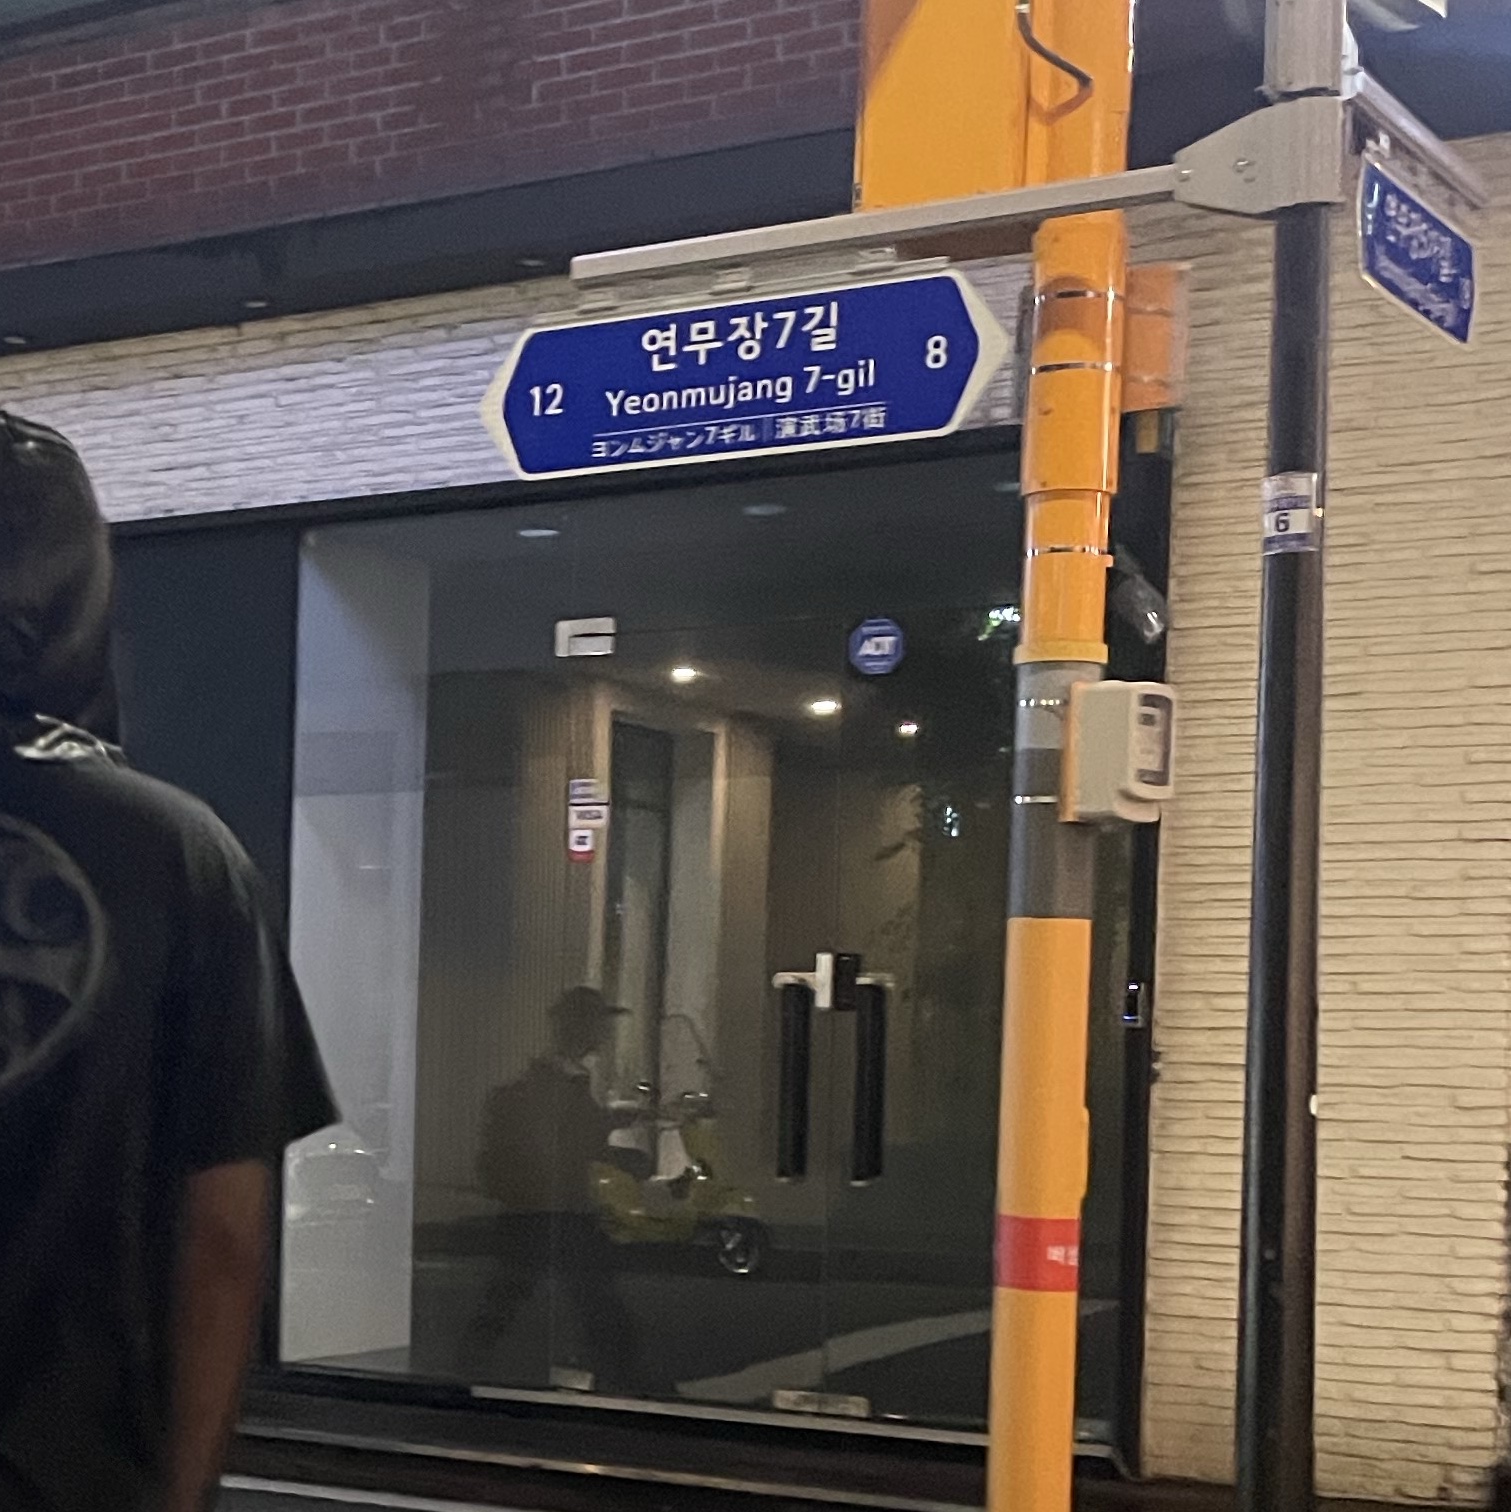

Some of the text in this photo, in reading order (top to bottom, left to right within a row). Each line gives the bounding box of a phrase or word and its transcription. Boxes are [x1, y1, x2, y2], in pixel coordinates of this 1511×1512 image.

[641, 300, 839, 372] 연무장7길
[924, 335, 949, 370] 8
[529, 383, 564, 416] 12
[605, 359, 876, 418] Yeonmujang 7-gil
[1275, 512, 1290, 533] 6
